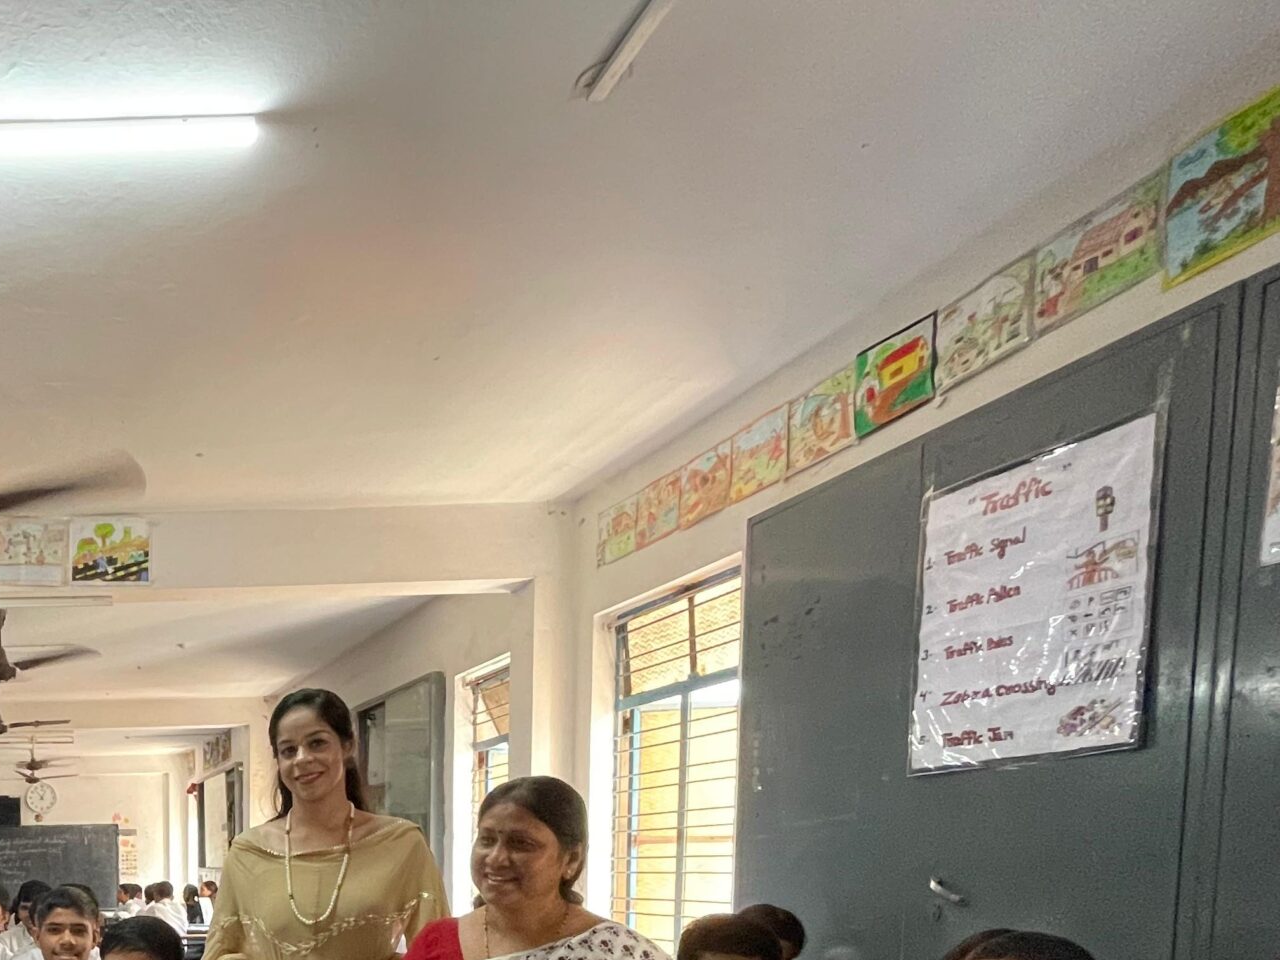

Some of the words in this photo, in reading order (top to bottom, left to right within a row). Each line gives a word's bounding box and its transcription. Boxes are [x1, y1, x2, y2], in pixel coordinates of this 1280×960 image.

[944, 542, 984, 566] Traffic
[989, 526, 1027, 560] Signal
[946, 593, 985, 613] Traffic
[995, 679, 1056, 696] Crossing
[942, 729, 984, 748] Traffic
[987, 727, 1014, 742] Jam
